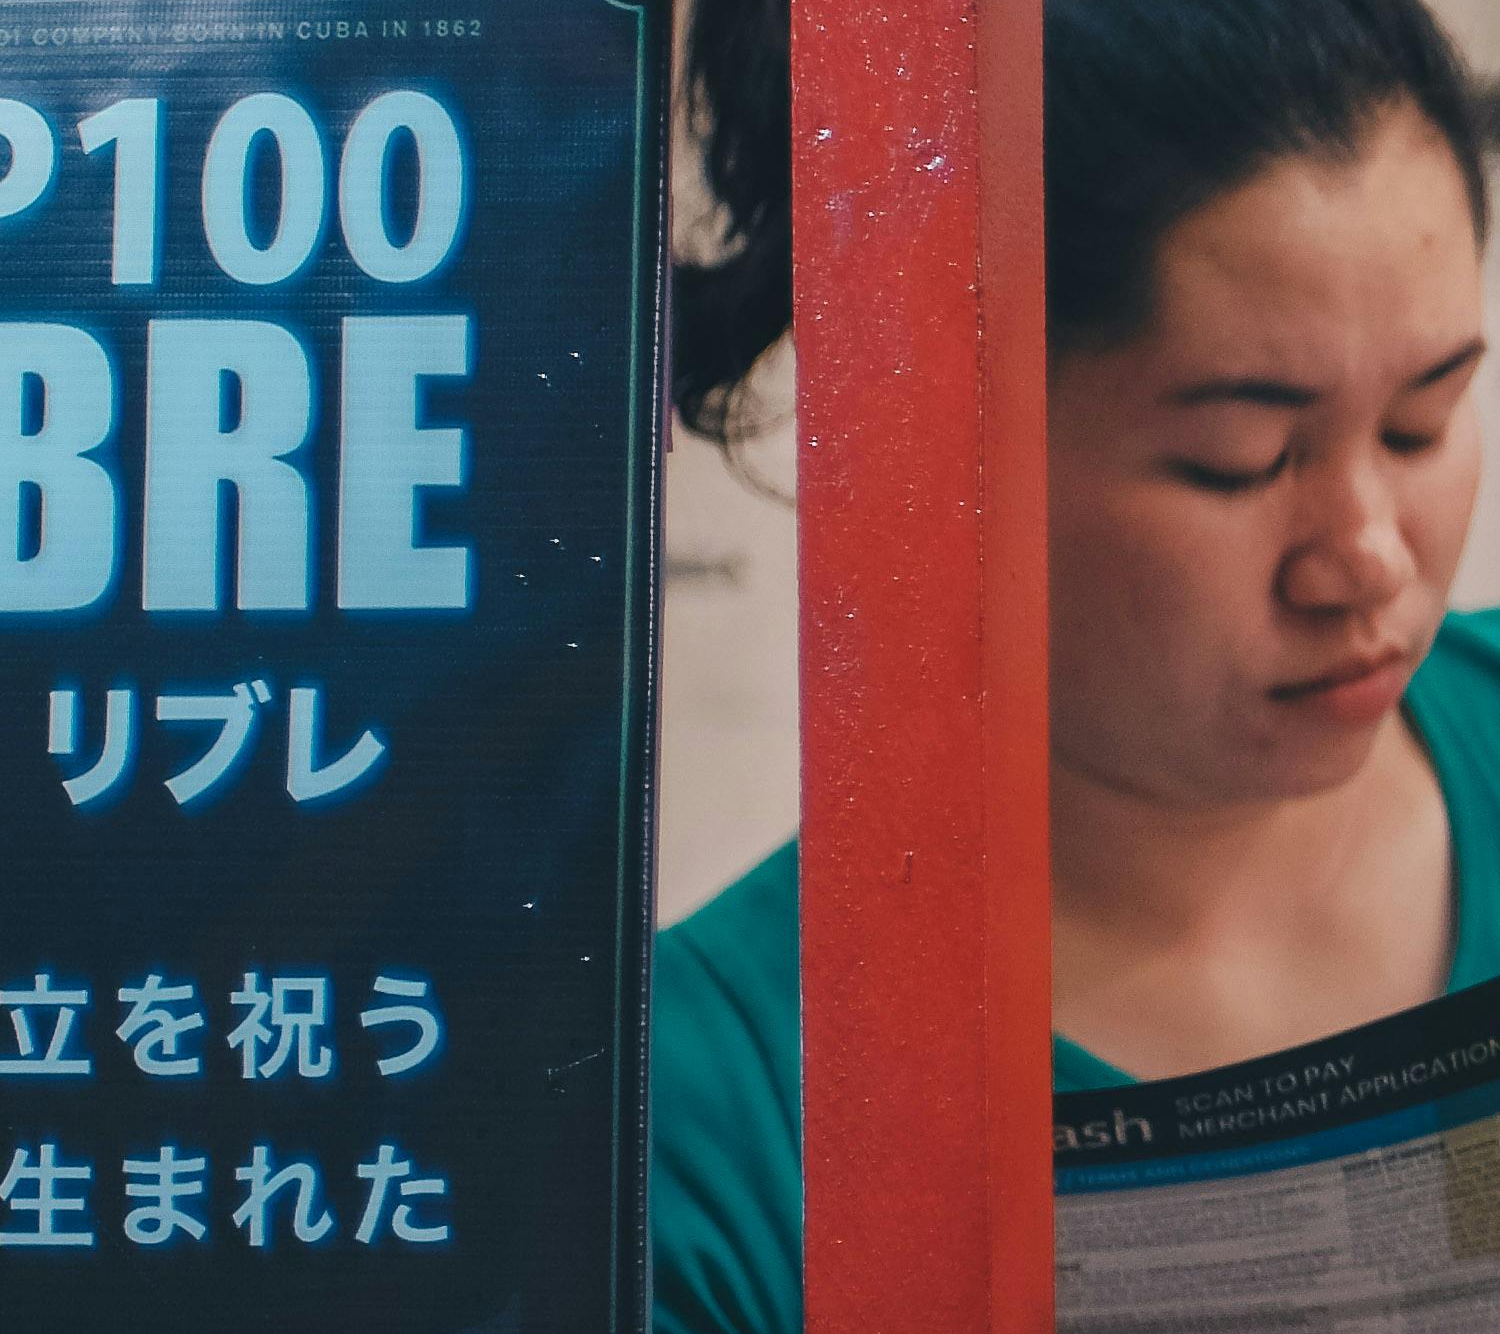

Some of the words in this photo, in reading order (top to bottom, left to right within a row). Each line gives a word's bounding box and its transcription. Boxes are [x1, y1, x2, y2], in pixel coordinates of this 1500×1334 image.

[296, 20, 369, 40] CUBA
[382, 19, 407, 38] IN
[423, 18, 484, 38] 1862
[0, 315, 470, 613] BRE
[48, 679, 385, 805] リブレ
[0, 972, 440, 1079] 立を祝う
[1174, 1086, 1254, 1116] SCAN
[1262, 1071, 1297, 1099] TO
[1303, 1053, 1356, 1086] PAY
[1178, 1093, 1330, 1141] MERCHANT
[0, 1142, 450, 1247] 生まれた
